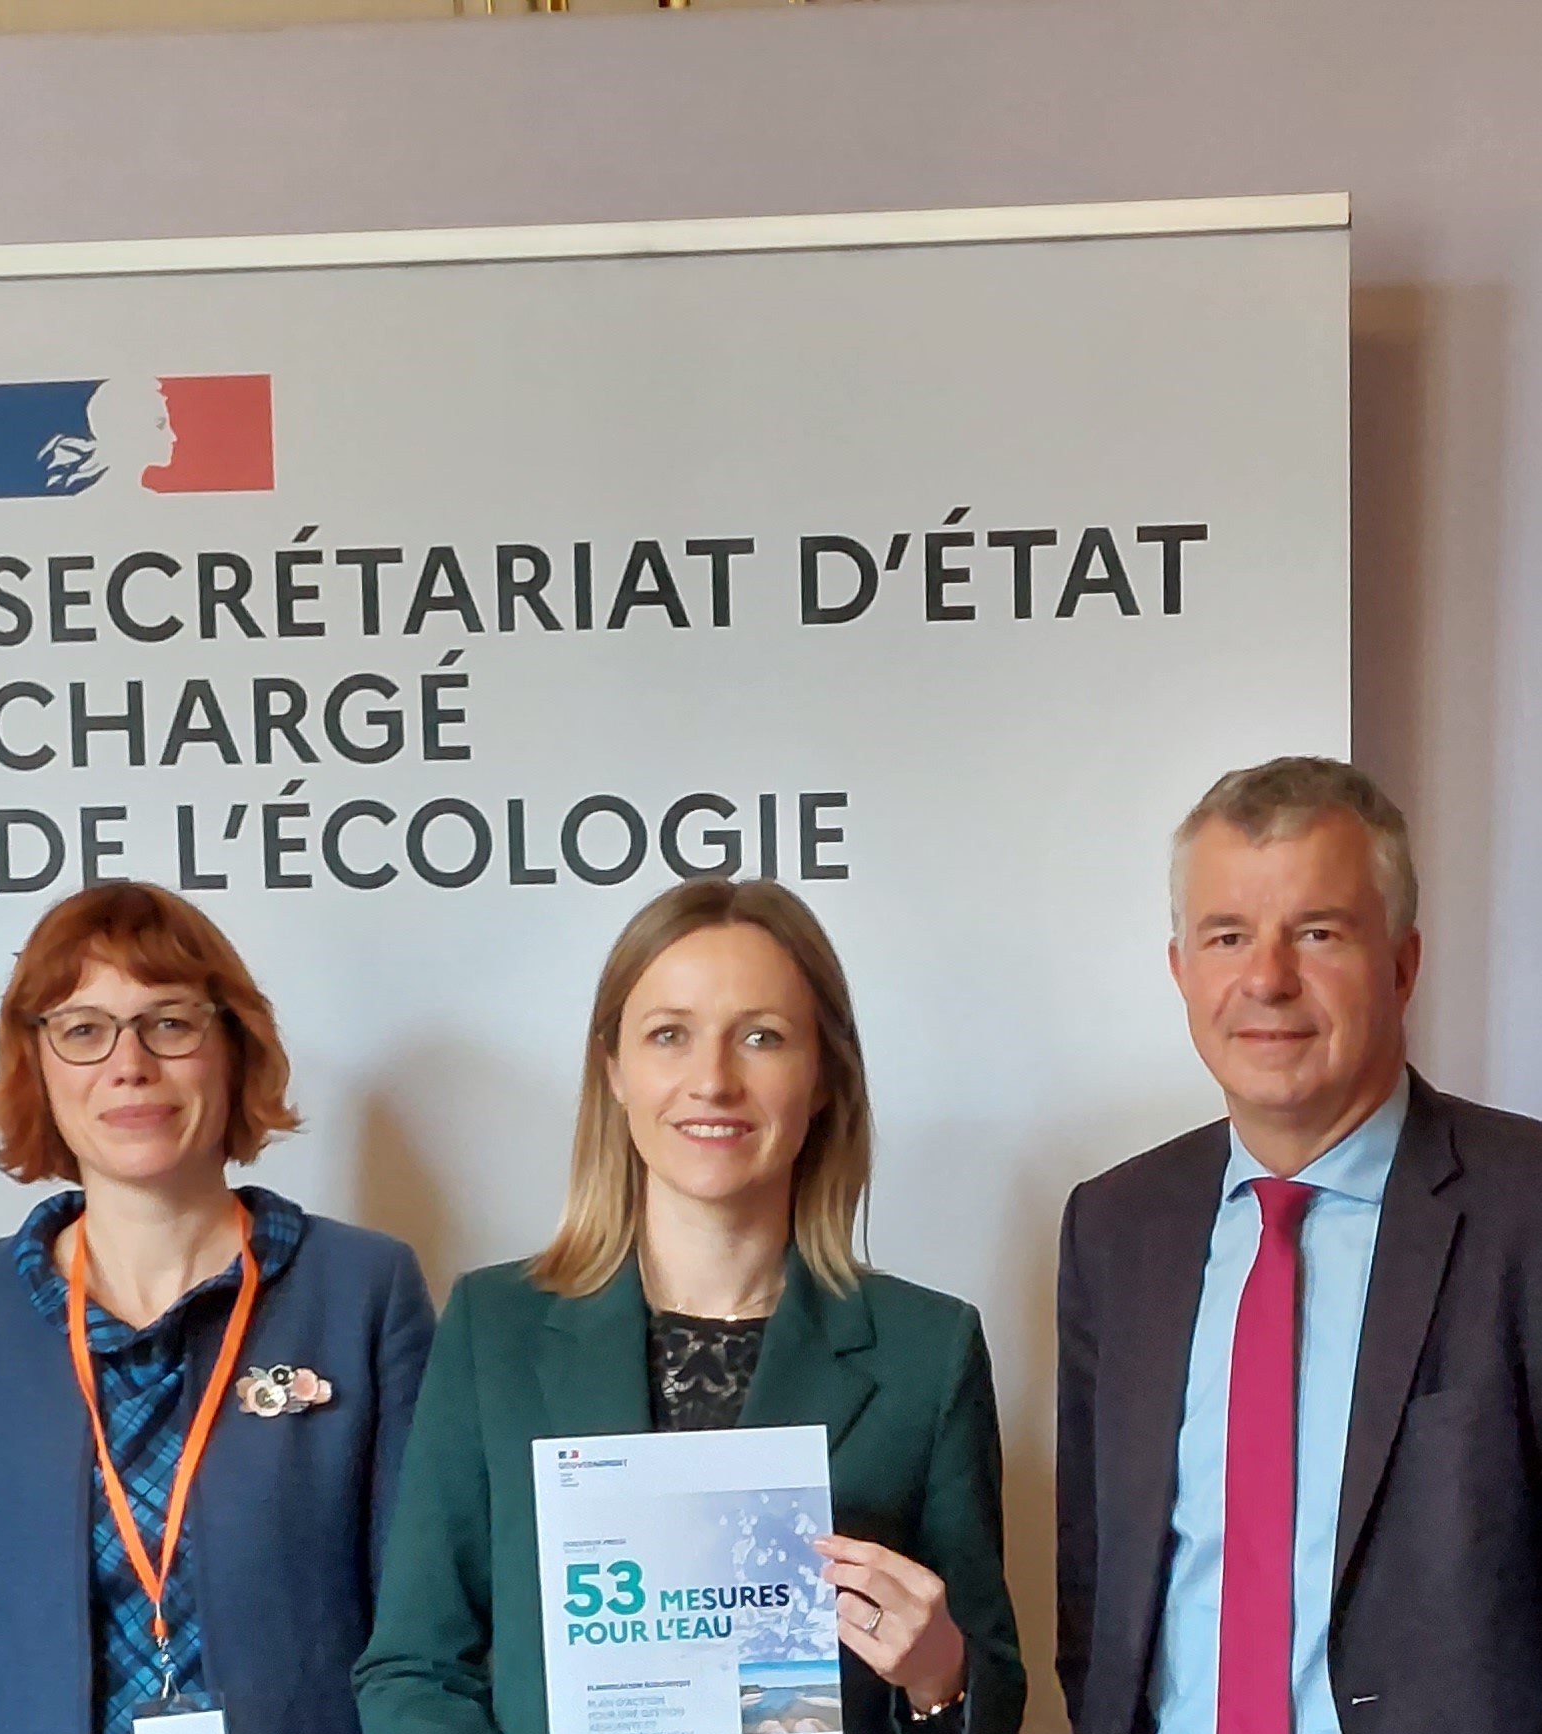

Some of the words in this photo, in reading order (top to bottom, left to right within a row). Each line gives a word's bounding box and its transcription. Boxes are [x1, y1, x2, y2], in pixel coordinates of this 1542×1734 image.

[800, 506, 1209, 625] D'ÉTAT
[176, 779, 850, 891] L'ÉCOLOGIE
[563, 1560, 646, 1617] 53
[660, 1584, 790, 1612] MESURES
[568, 1621, 649, 1645] POUR
[656, 1615, 732, 1641] L'EAU
